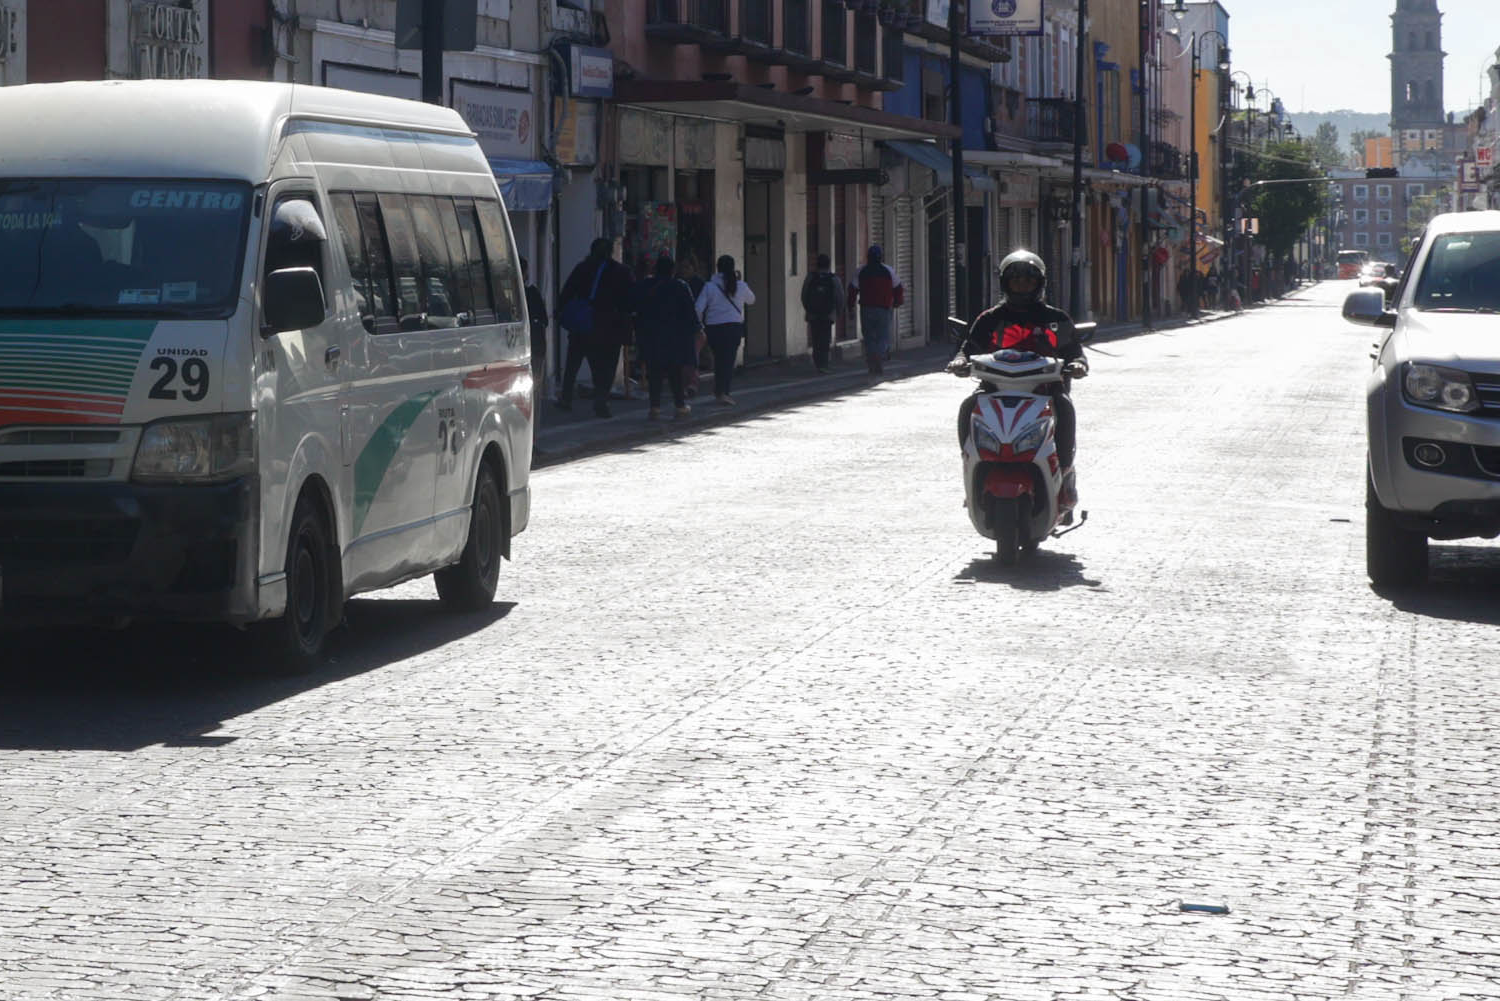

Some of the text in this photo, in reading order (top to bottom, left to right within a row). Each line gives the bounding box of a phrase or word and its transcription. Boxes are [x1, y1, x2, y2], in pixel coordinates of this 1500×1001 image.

[146, 2, 202, 45] TORTAS
[1477, 147, 1491, 160] WC
[130, 189, 244, 212] CENTRO
[156, 347, 209, 357] UNIDAD
[148, 356, 210, 402] 29
